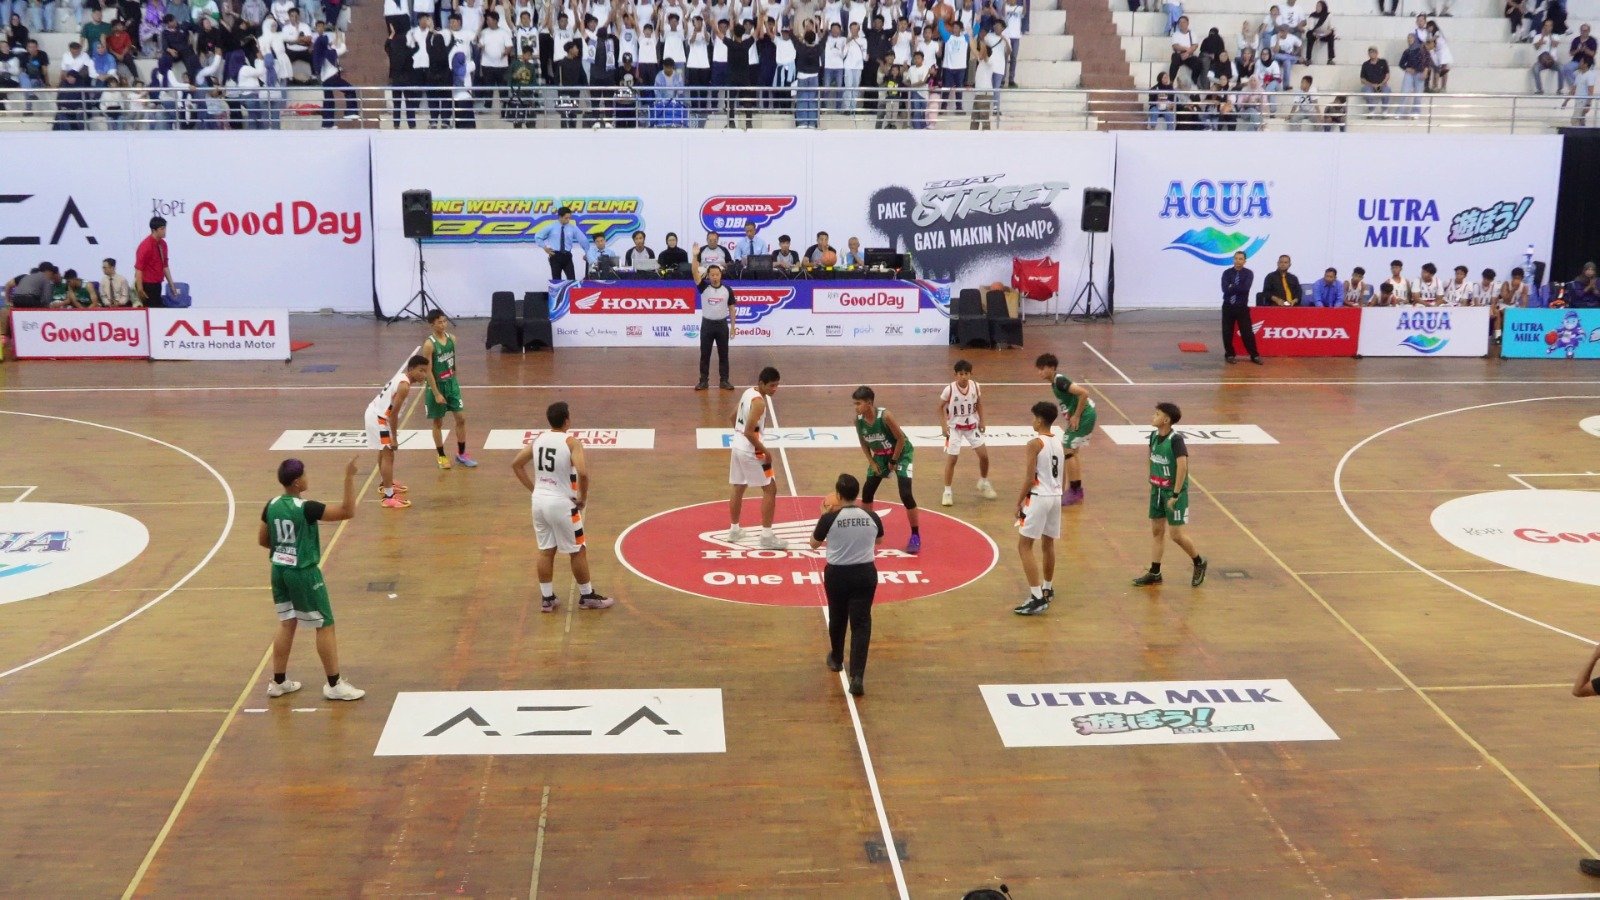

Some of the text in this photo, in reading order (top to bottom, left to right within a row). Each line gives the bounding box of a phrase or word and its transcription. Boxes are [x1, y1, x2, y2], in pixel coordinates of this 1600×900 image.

[467, 200, 529, 214] WORTH
[587, 200, 638, 214] CUMA
[725, 204, 774, 212] HONDA
[877, 202, 907, 220] PAKE
[912, 182, 1069, 226] STREET
[1159, 179, 1273, 226] AQUA
[1358, 198, 1440, 221] ULTRA
[192, 201, 284, 237] Good
[292, 201, 362, 244] Day
[914, 231, 946, 251] GAYA
[950, 226, 993, 247] MAKIN
[1364, 226, 1431, 247] MILK
[601, 298, 690, 310] HONDA
[840, 292, 876, 306] Good
[877, 292, 904, 309] Day
[165, 320, 276, 337] AHM
[1396, 311, 1452, 333] AQUA
[1511, 322, 1544, 332] ULTRA
[41, 321, 96, 342] Good
[98, 321, 140, 347] Day
[756, 327, 771, 337] Day
[1262, 327, 1350, 339] HONDA
[1514, 333, 1541, 342] MILK
[163, 340, 275, 349] PT Astra Honda Motor
[538, 447, 556, 472] 15
[837, 516, 871, 528] REFEREE
[274, 519, 296, 543] 10
[700, 549, 918, 559] HONA
[702, 570, 931, 585] One HRT.
[1006, 688, 1283, 707] ULTRA MILK
